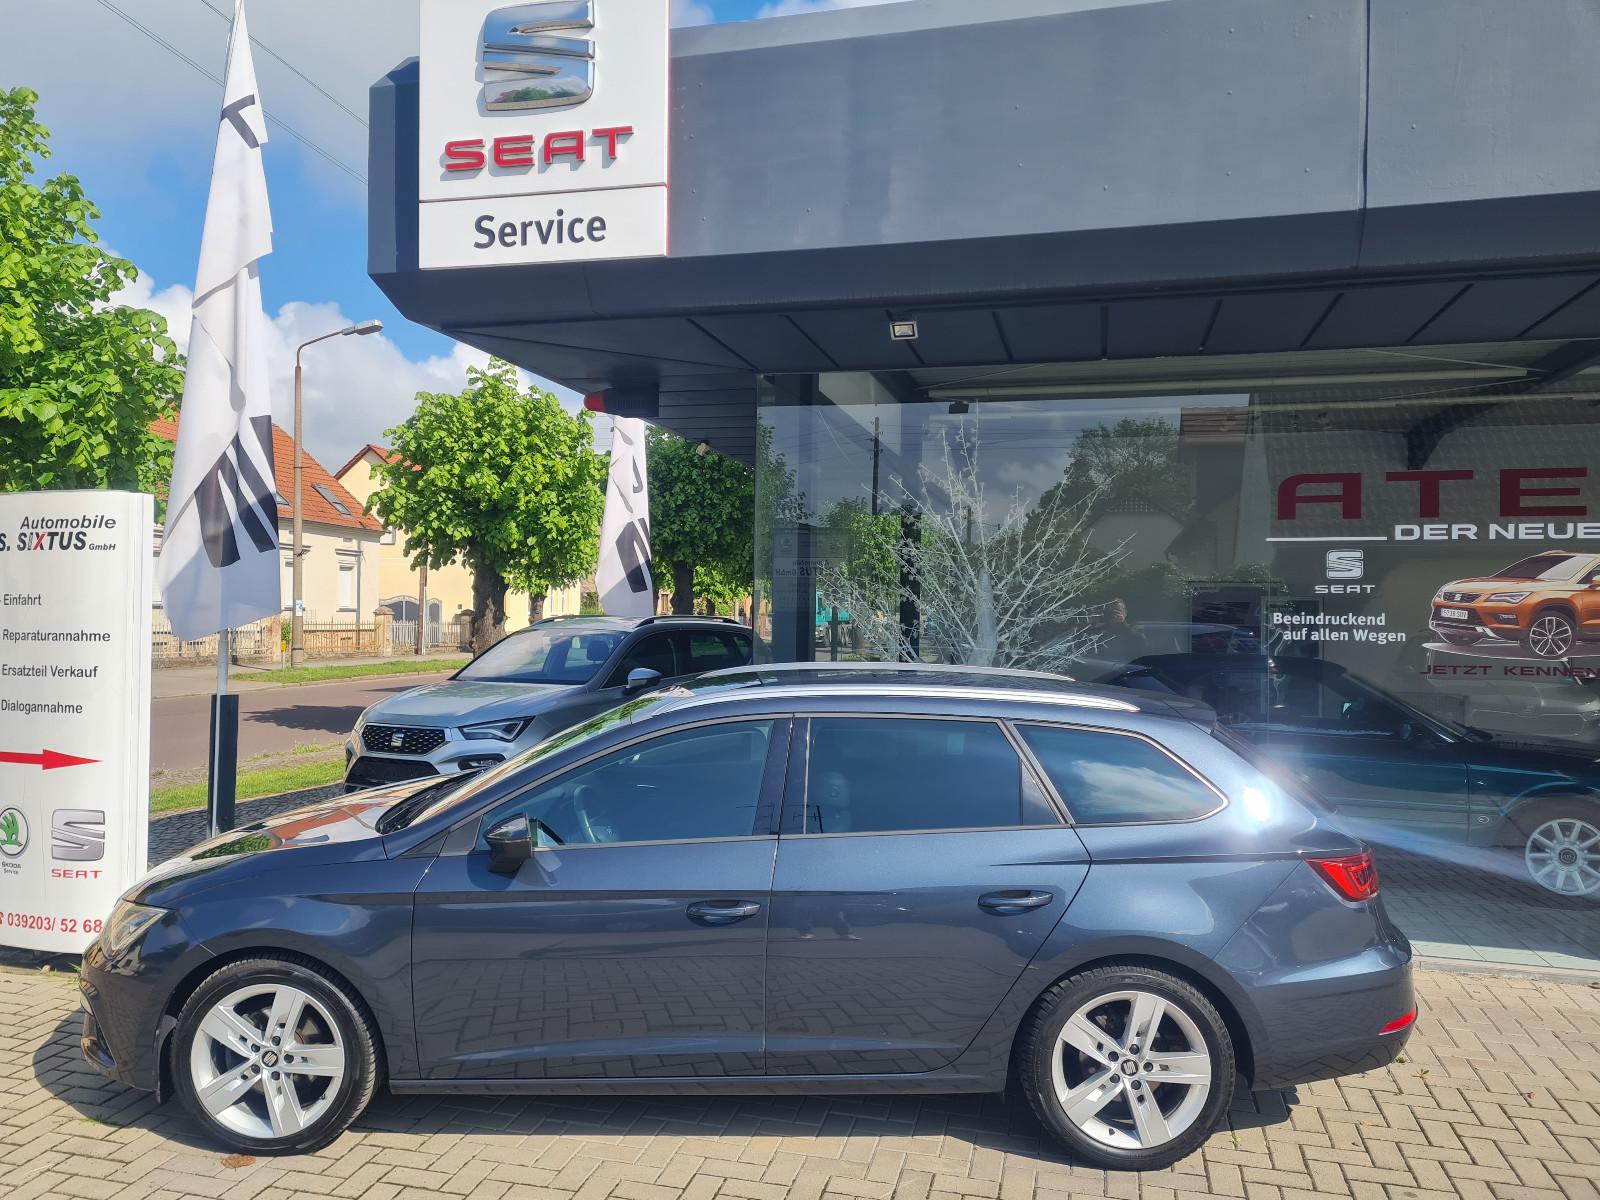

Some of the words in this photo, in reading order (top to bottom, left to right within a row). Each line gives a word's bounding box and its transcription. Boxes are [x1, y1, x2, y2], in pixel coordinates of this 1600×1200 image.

[444, 126, 634, 173] SEAT
[473, 208, 607, 249] Service
[1277, 467, 1588, 520] ATE
[20, 515, 117, 530] Automobile
[1394, 524, 1478, 540] DER
[1489, 522, 1600, 540] NEUE
[88, 543, 116, 551] GmbH
[1314, 584, 1376, 594] SEAT
[3, 594, 42, 606] Einfahrt
[1273, 612, 1386, 626] Beeindruckend
[2, 628, 111, 643] Reparaturannahme
[1283, 627, 1308, 641] auf
[1310, 627, 1349, 641] allen
[1353, 629, 1406, 645] Wegen
[1, 663, 47, 677] Ersatzteil
[50, 665, 99, 678] Verkauf
[1419, 665, 1493, 675] JETZT
[1, 699, 83, 715] Dialogannahme
[51, 868, 103, 879] SEAT
[7, 912, 56, 931] 039203/
[60, 918, 77, 933] 52
[82, 919, 103, 933] 68
